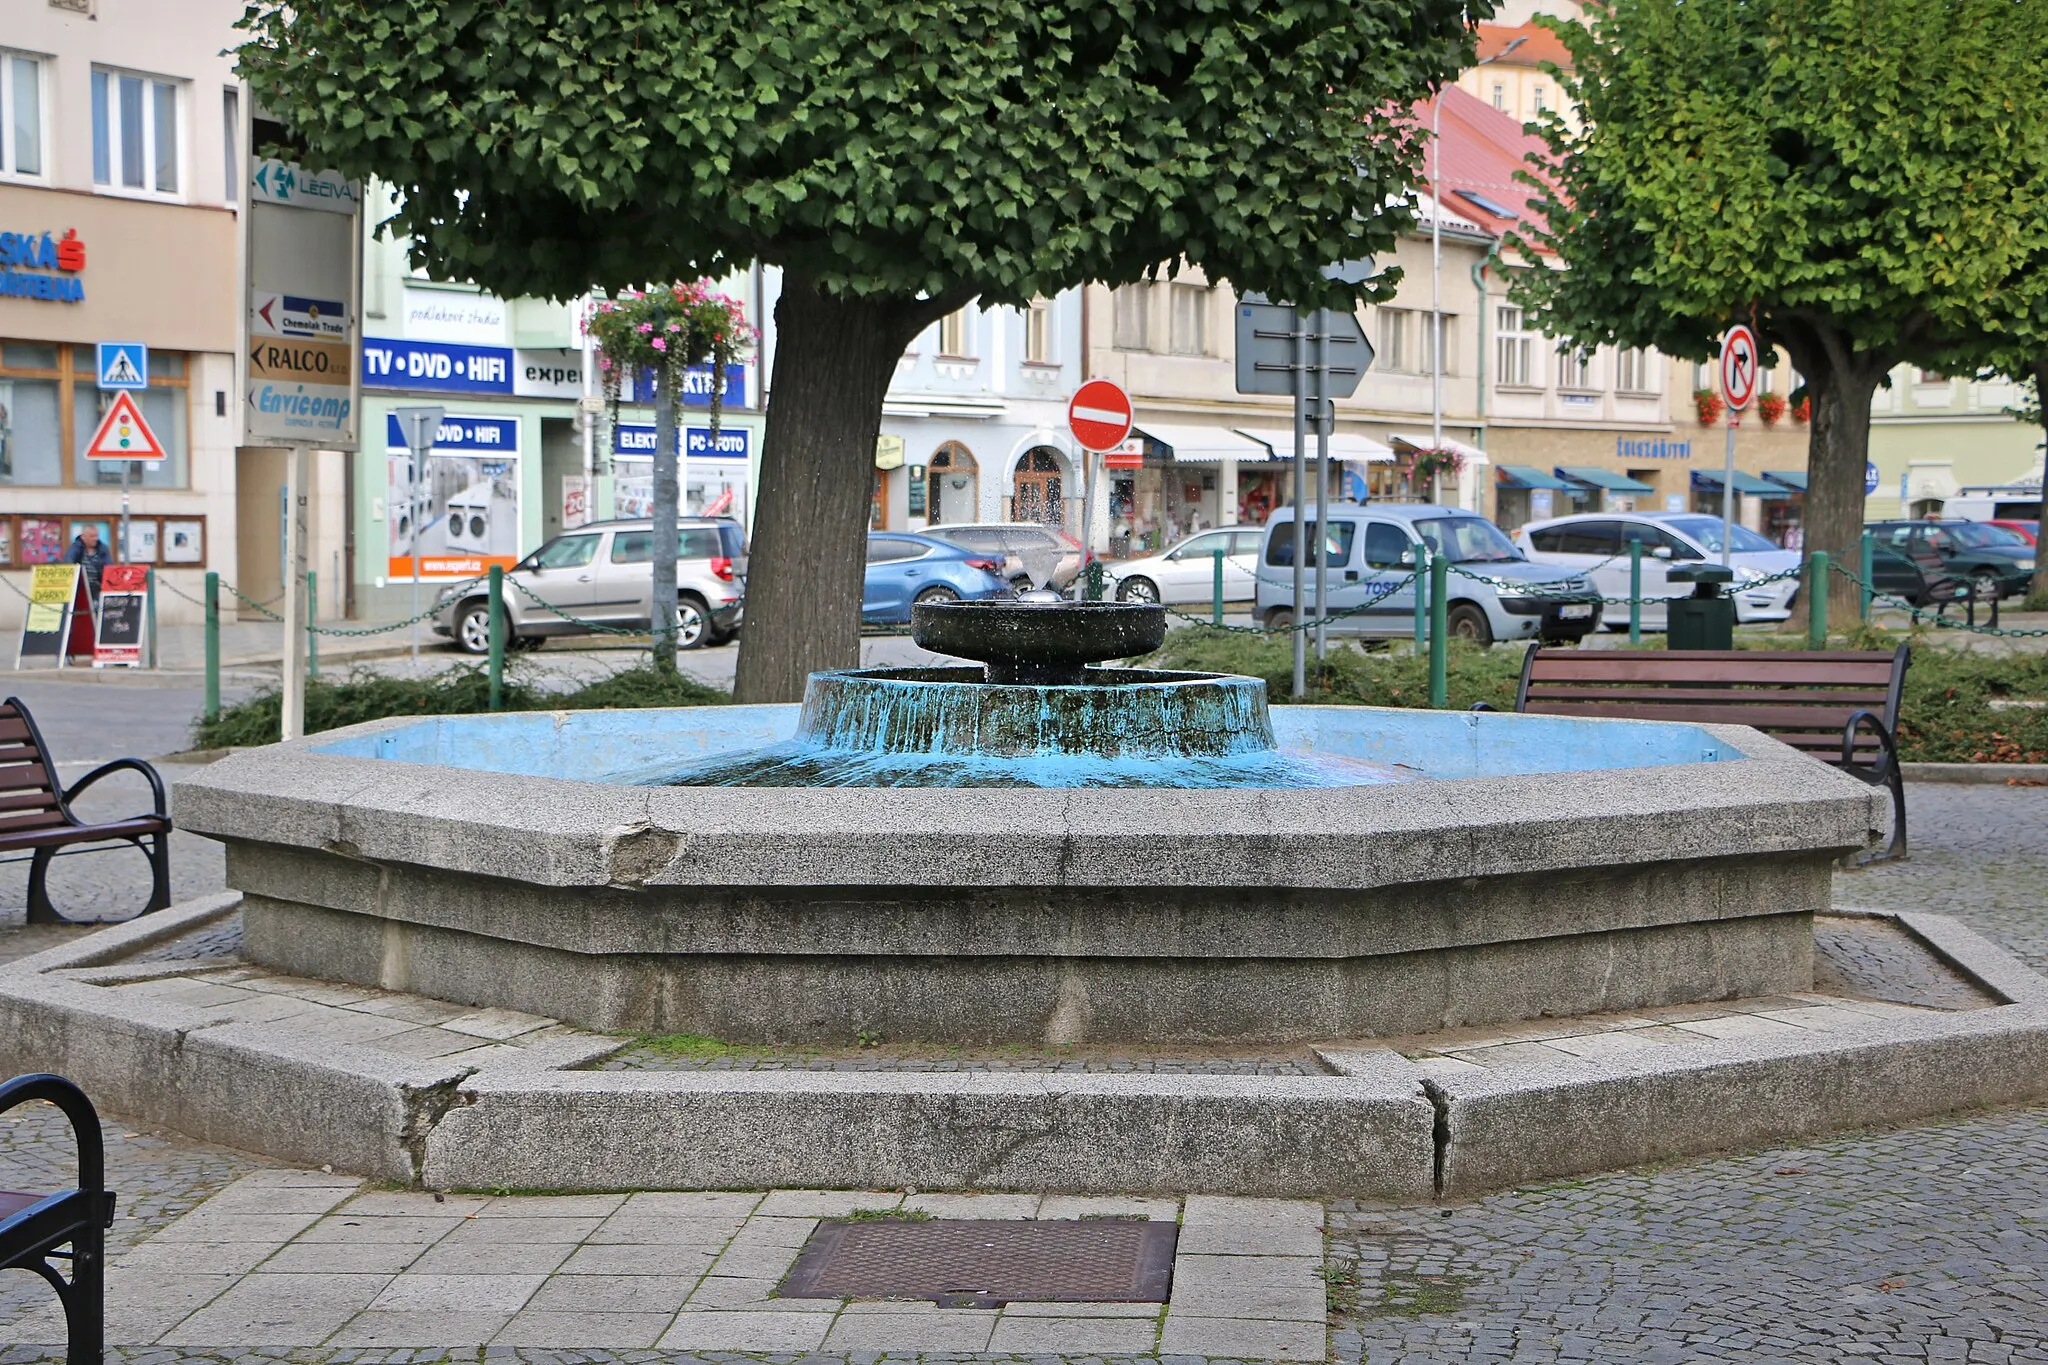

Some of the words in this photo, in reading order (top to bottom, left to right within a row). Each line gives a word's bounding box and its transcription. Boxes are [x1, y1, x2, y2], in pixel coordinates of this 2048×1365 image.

[282, 317, 320, 330] Chemolak
[322, 321, 343, 333] Trade
[268, 346, 328, 373] RALCO
[365, 348, 392, 375] TV
[409, 352, 451, 379] DVD
[468, 356, 505, 383] HIFI
[526, 366, 595, 386] expe
[259, 384, 351, 430] Envicomp
[475, 427, 500, 443] HIFI
[689, 435, 706, 451] PC
[716, 436, 745, 452] FOTO
